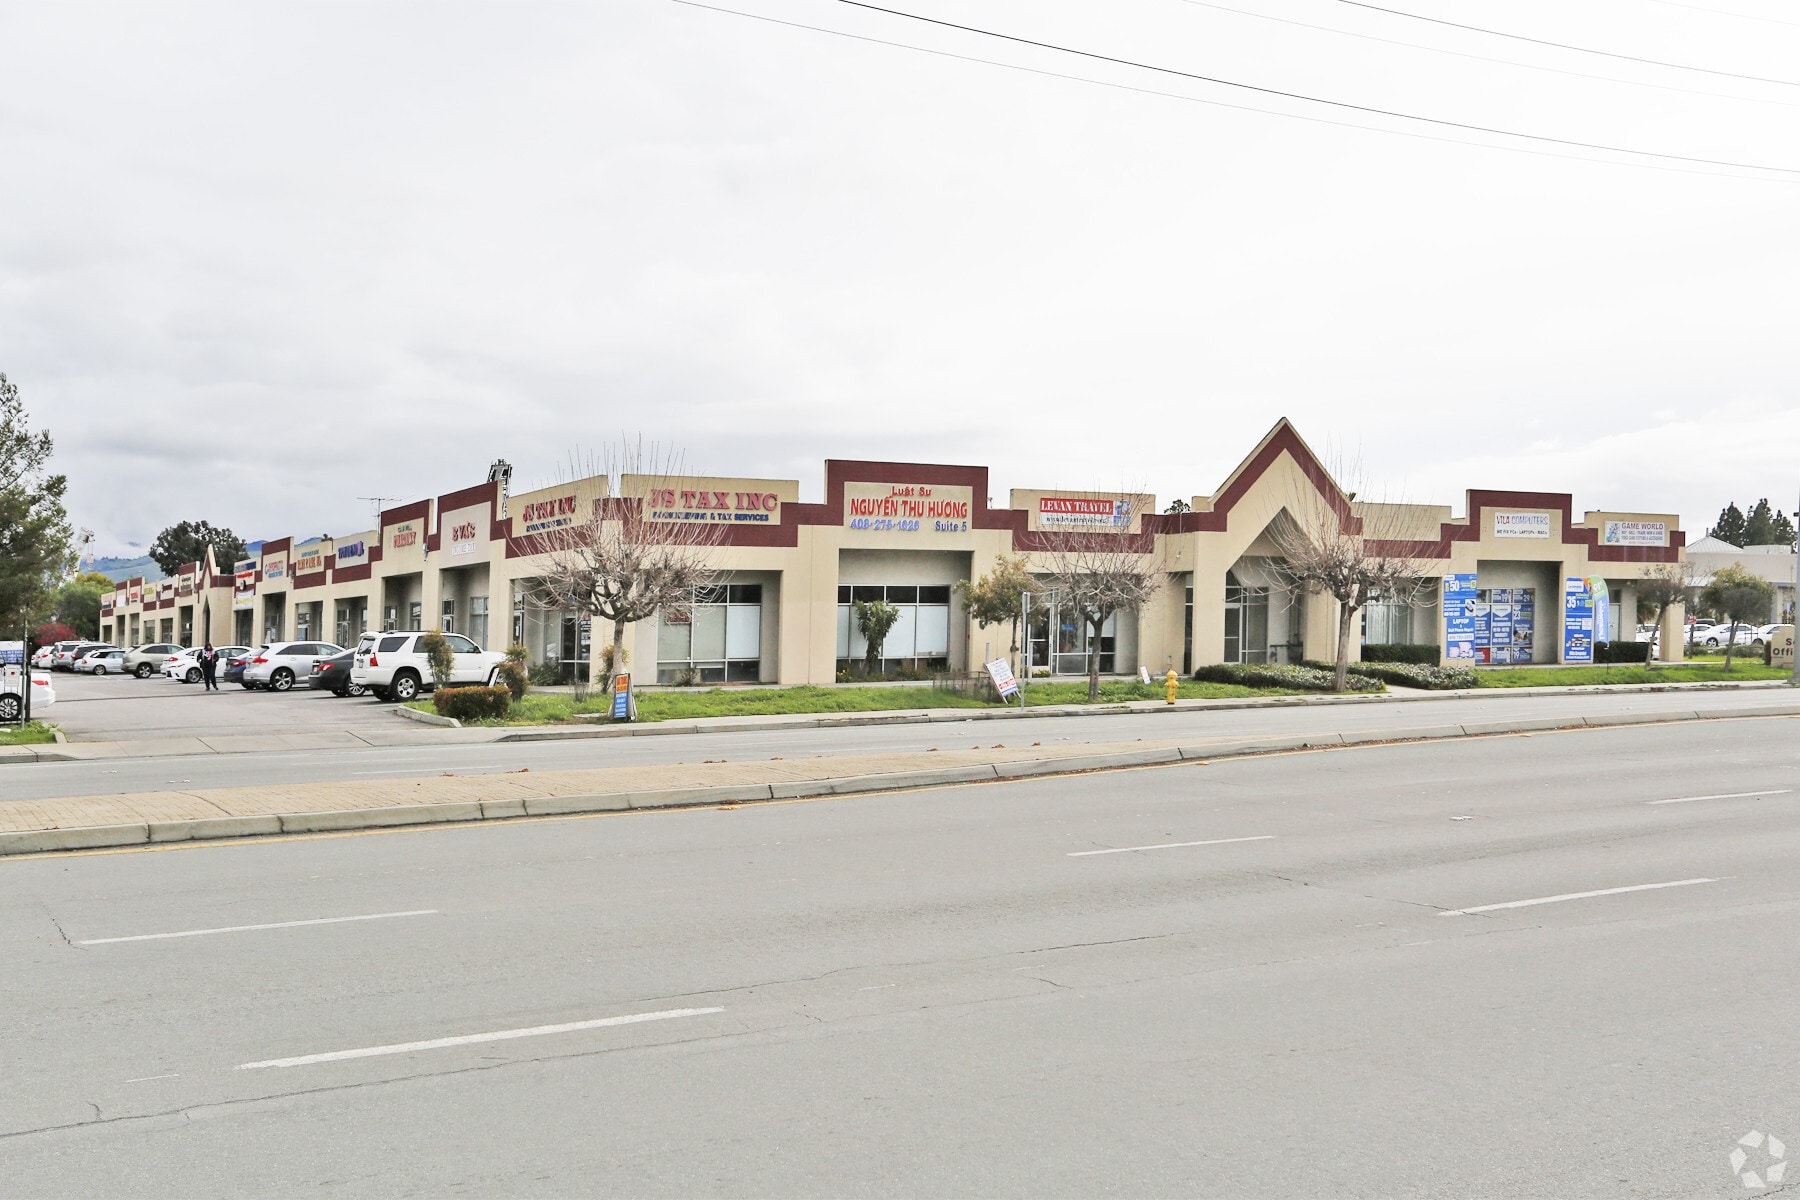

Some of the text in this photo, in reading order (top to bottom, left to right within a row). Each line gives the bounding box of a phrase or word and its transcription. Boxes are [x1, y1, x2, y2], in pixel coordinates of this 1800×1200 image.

[647, 488, 778, 511] JS TAX INC
[901, 499, 925, 517] THU
[1041, 500, 1112, 514] LEVAN TRAVEL
[717, 512, 732, 521] TAX
[734, 513, 769, 522] SERVICES
[1511, 515, 1548, 526] COMPUTERS
[935, 520, 959, 532] Suite
[961, 521, 967, 532] 5
[1621, 522, 1640, 530] GAME
[1566, 595, 1577, 609] 35
